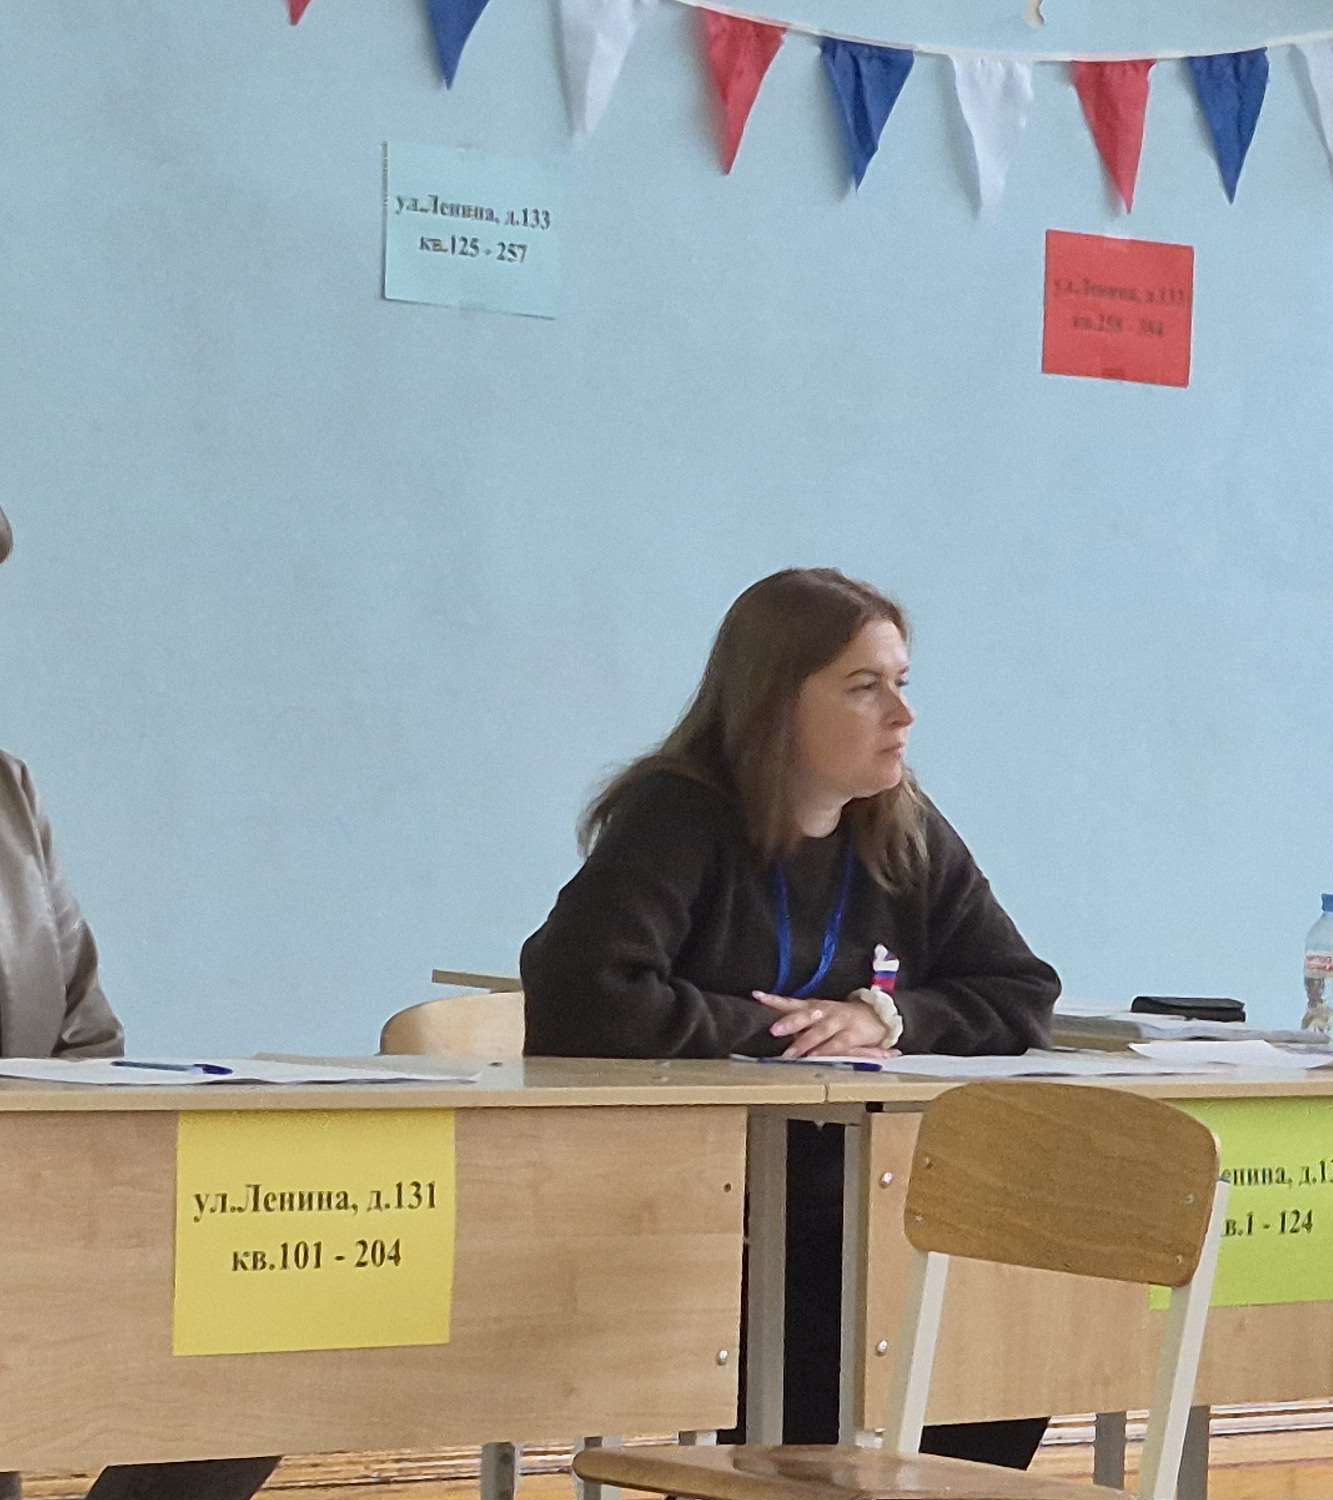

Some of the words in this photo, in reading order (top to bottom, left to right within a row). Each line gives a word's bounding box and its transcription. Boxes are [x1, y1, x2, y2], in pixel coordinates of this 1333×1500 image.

[496, 242, 528, 263] 257
[1219, 1166, 1294, 1191] енина,
[193, 1183, 359, 1223] ул.Ленина,
[366, 1180, 437, 1213] д.131
[1220, 1210, 1254, 1237] в.1
[1277, 1209, 1314, 1236] 124
[231, 1240, 323, 1272] кв.101
[354, 1238, 402, 1269] 204
